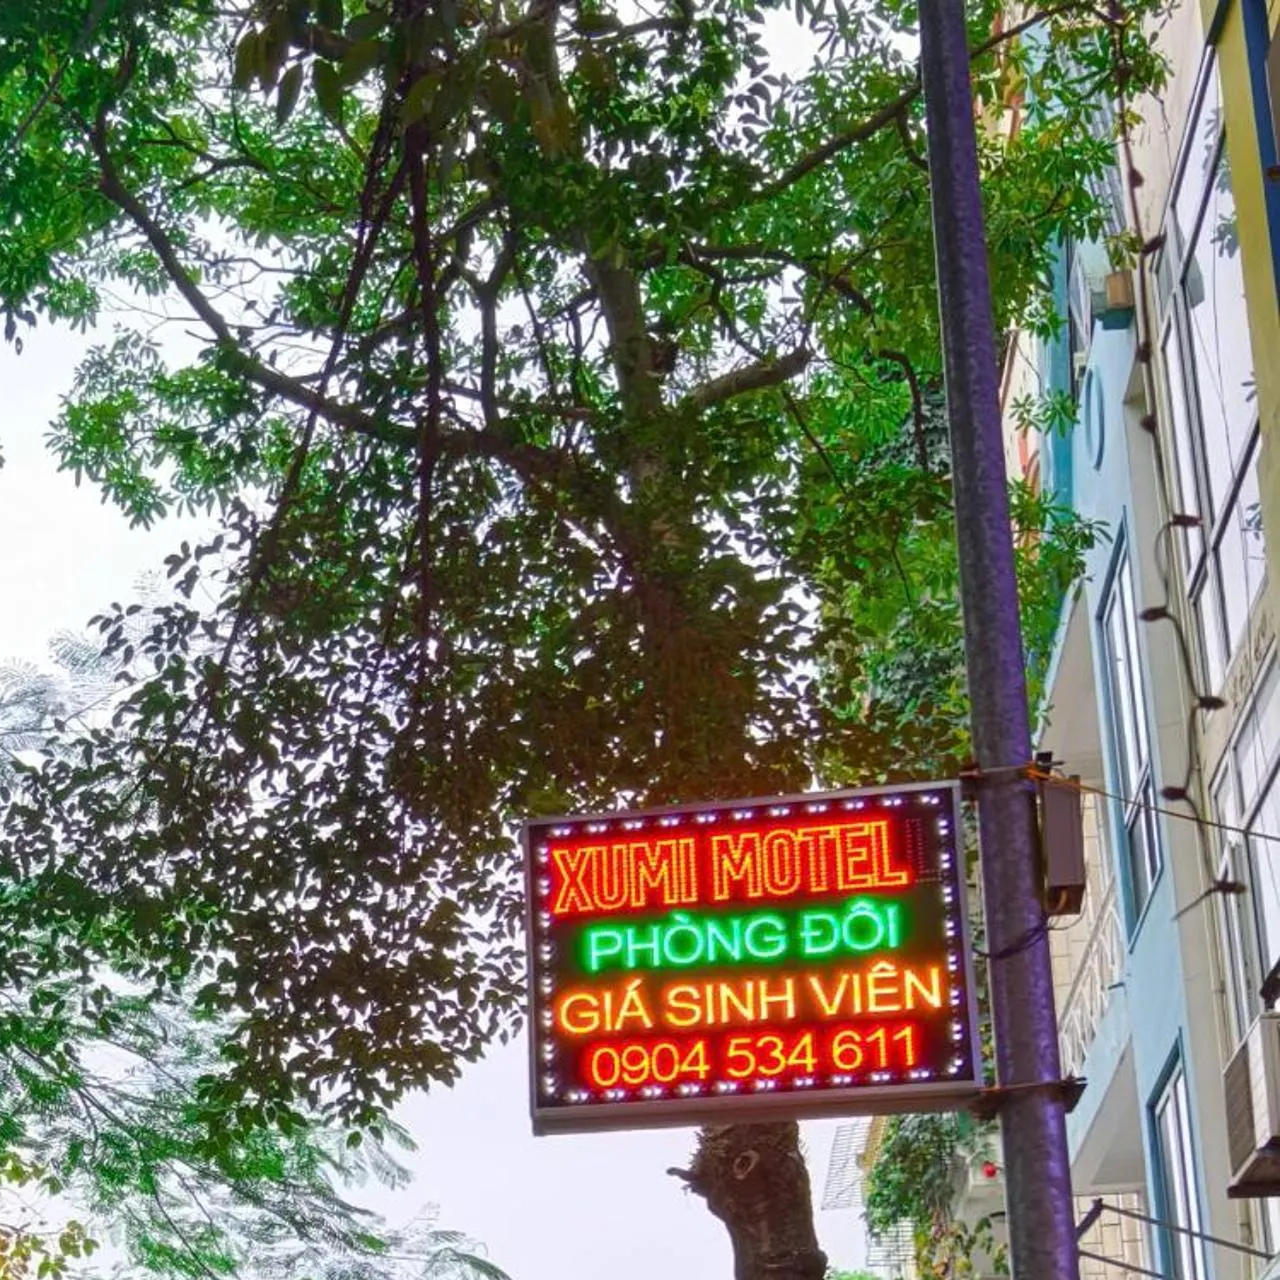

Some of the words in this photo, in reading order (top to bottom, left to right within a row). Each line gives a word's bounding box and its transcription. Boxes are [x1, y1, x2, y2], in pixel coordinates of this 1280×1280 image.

[553, 837, 698, 914] XUMI
[712, 820, 908, 901] MOTEL
[589, 913, 786, 971] PHÒNG
[800, 900, 899, 954] ĐÔI
[559, 979, 652, 1034] GIÁ
[666, 978, 795, 1028] SINH
[809, 961, 942, 1017] VIÊN
[591, 1042, 710, 1087] 0904
[726, 1034, 817, 1078] 534
[832, 1026, 916, 1071] 611
